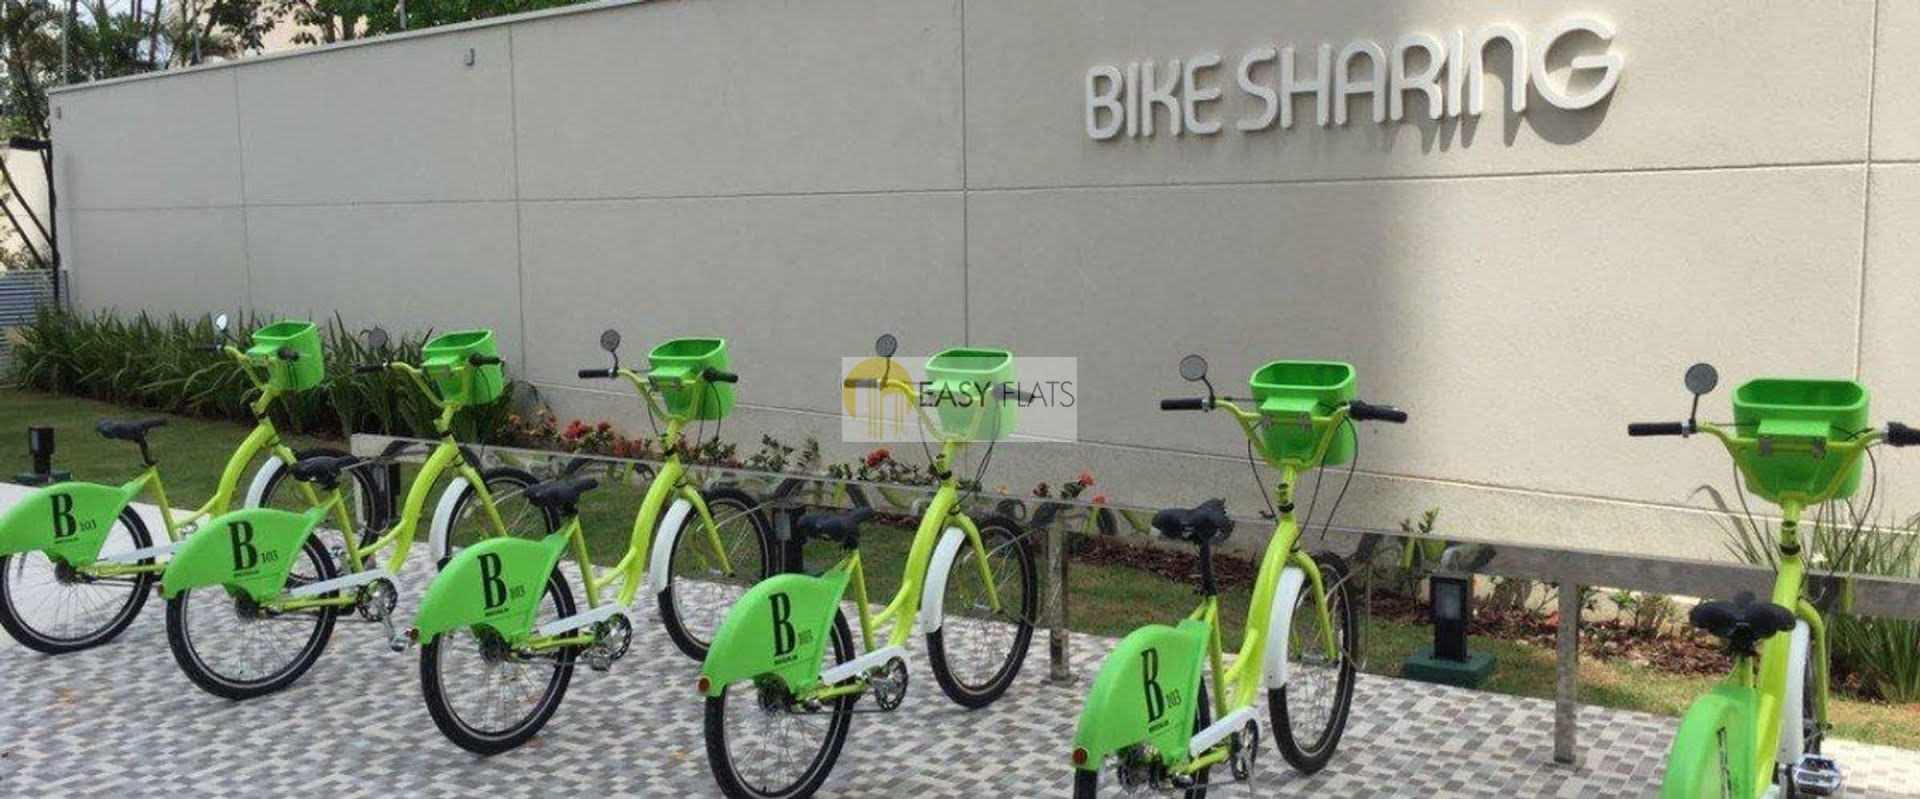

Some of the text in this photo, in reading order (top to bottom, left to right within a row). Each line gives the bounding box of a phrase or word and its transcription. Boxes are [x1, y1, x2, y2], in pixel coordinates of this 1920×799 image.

[1085, 18, 1625, 140] BIKE SHARING
[50, 493, 77, 538] B
[227, 521, 258, 571] B
[477, 552, 507, 610] B
[768, 592, 796, 657] B
[1141, 648, 1165, 722] B
